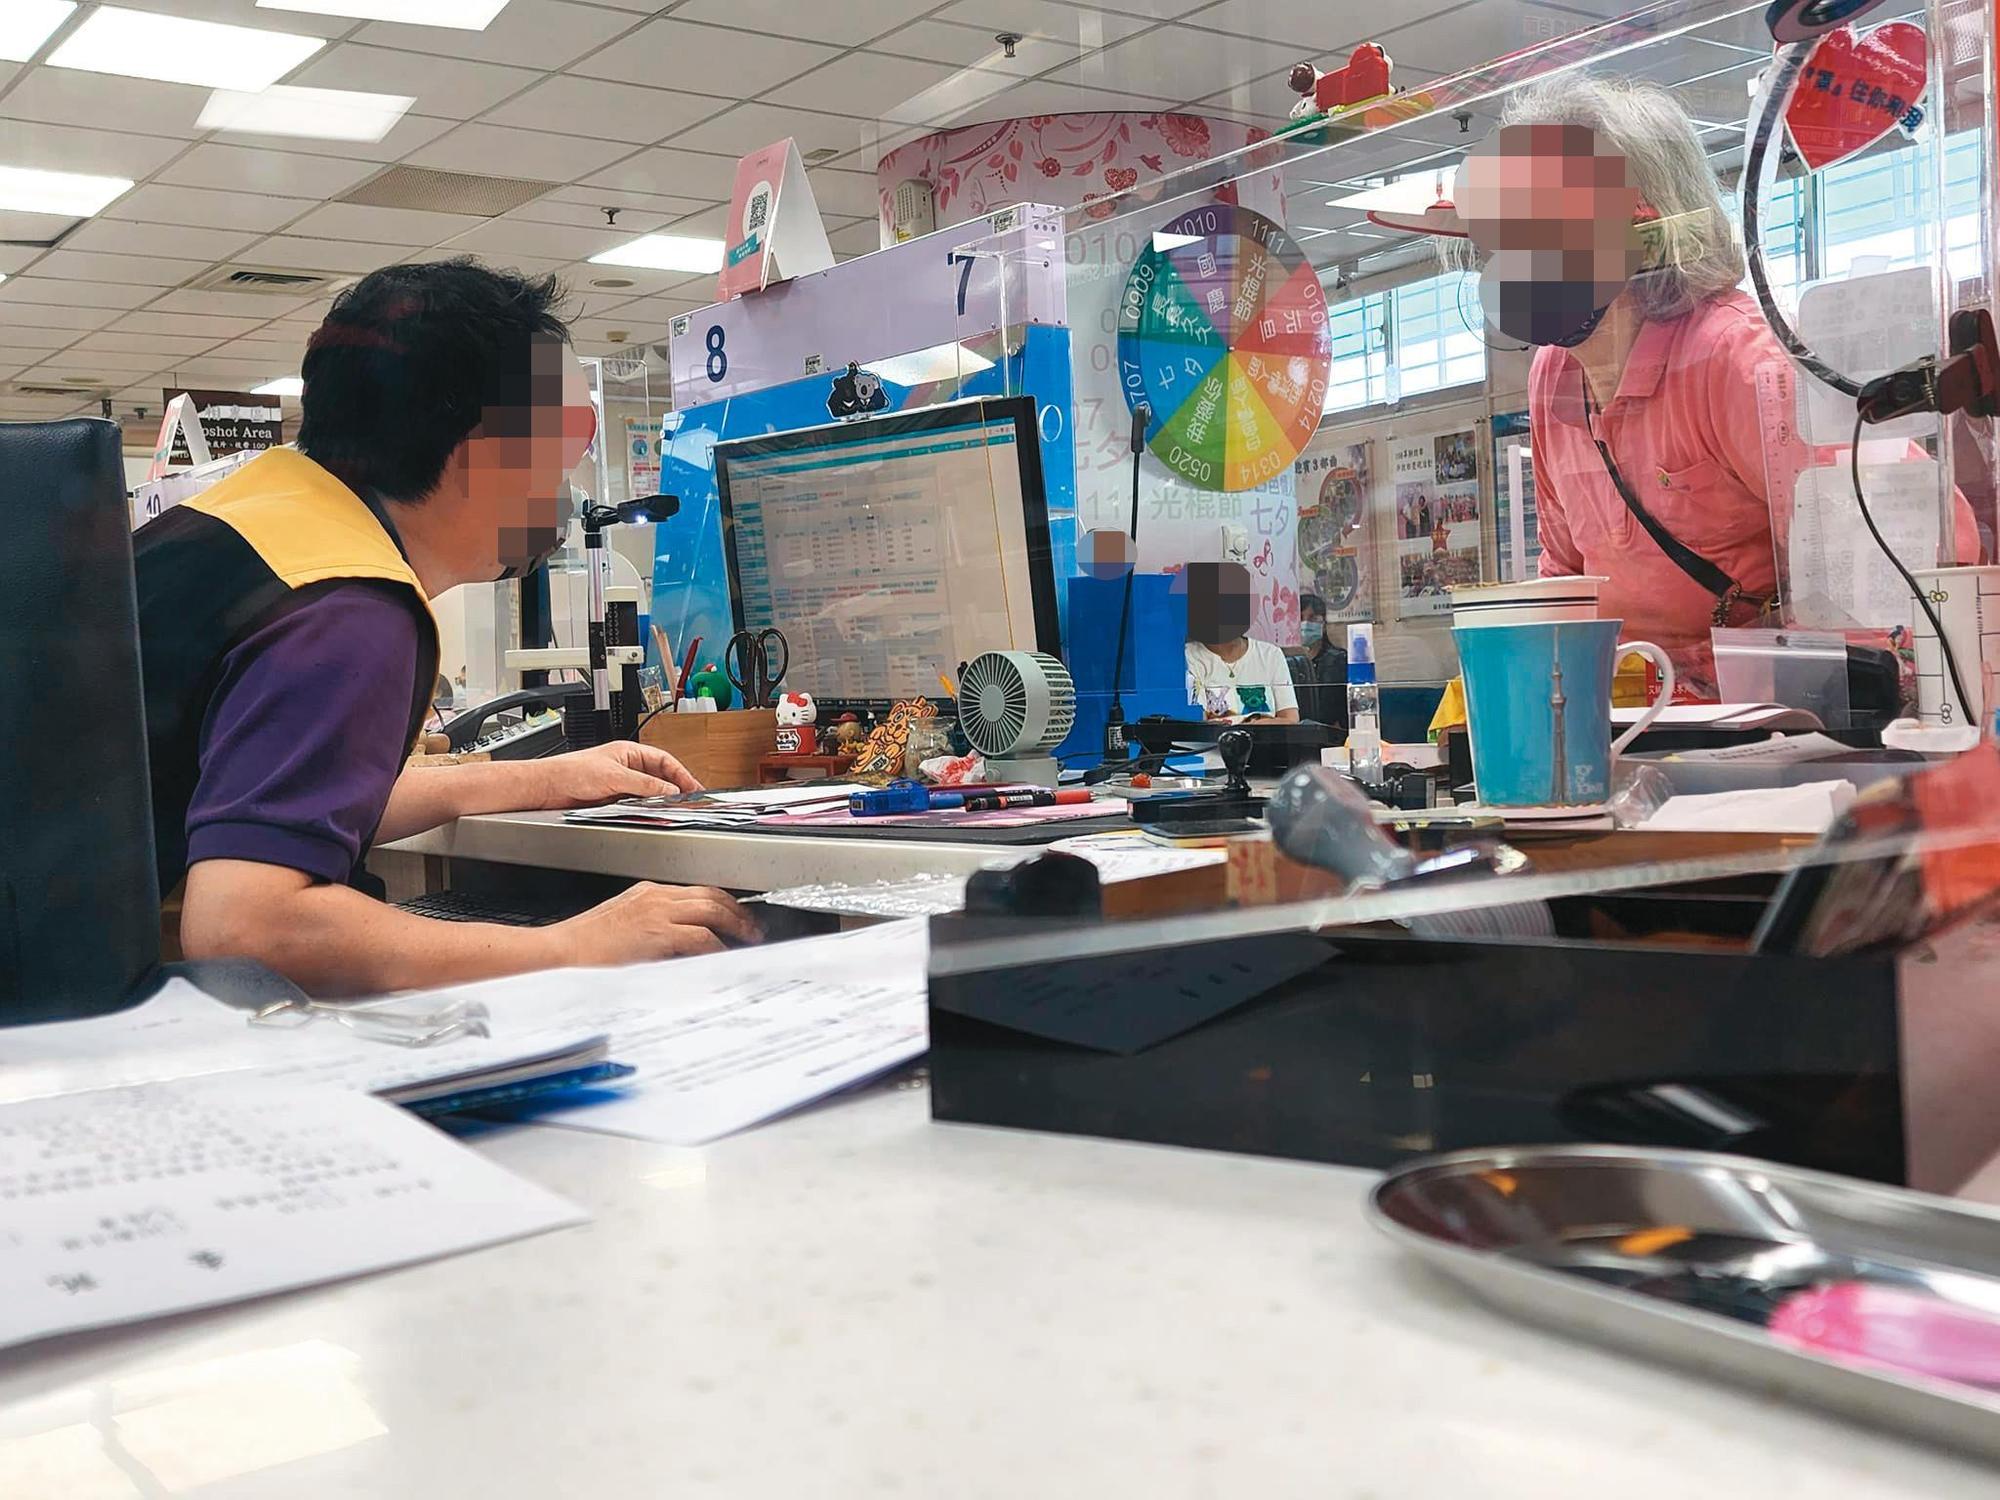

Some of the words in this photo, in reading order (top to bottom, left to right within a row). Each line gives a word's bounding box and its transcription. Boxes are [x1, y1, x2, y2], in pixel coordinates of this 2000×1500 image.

[1252, 219, 1285, 254] 1111
[947, 252, 976, 316] 7
[1125, 264, 1154, 319] 0909
[1197, 252, 1228, 315] 國慶
[1232, 253, 1267, 321] 光棍節
[1152, 291, 1213, 346] 長長久久
[1259, 310, 1303, 343] 元旦
[705, 324, 728, 383] 8
[1158, 357, 1204, 390] 七夕
[1186, 376, 1224, 445] 我愛你
[1231, 376, 1262, 451] 白色情人節
[1299, 378, 1325, 432] 0214
[176, 426, 238, 439] Spshot
[243, 426, 273, 439] Area
[1169, 446, 1211, 481] 0520
[1241, 450, 1281, 484] 0314
[146, 493, 162, 516] 10
[1151, 487, 1243, 521] 光棍節
[1250, 497, 1290, 537] 七夕
